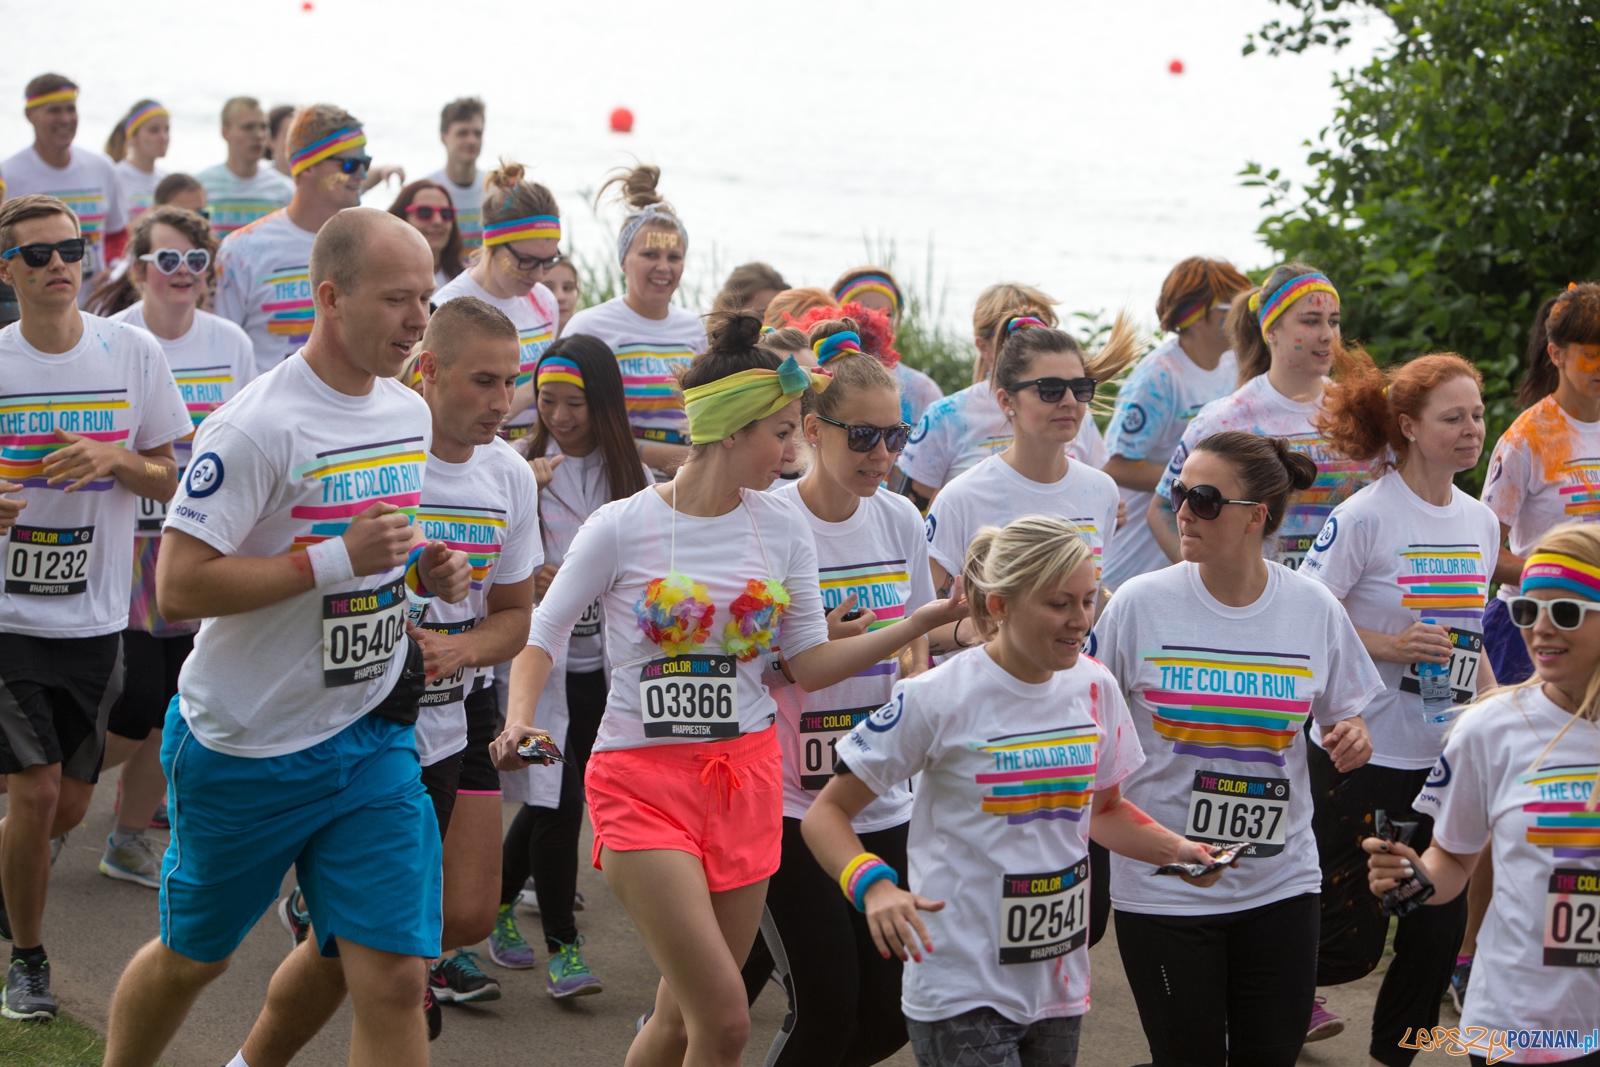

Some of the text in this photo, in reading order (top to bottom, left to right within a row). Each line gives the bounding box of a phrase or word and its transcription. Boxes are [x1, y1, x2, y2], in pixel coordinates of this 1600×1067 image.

[275, 282, 298, 300] THE
[620, 359, 644, 375] THE
[0, 412, 26, 434] THE
[29, 411, 80, 434] COLOR
[321, 463, 422, 502] THE COLOR RUN
[17, 529, 31, 542] THE
[32, 531, 58, 544] COLOR
[425, 521, 466, 541] COLOR
[468, 525, 494, 544] RUN
[12, 548, 88, 580] 01232
[1410, 558, 1477, 574] THE COLOR RUN
[29, 583, 70, 594] #HAPPIEST5K
[331, 590, 392, 614] THE COLOR RUN
[330, 614, 405, 664] 05404
[646, 660, 710, 677] THE COLOR RUN
[1160, 666, 1297, 699] THE COLOR RUN
[646, 682, 732, 718] 03366
[672, 724, 711, 735] #HAPPIEST5K
[806, 717, 822, 729] THE
[823, 715, 852, 728] COLOR
[993, 744, 1092, 771] THE COLOR RUN
[1201, 776, 1265, 796] THE COLOR RUN
[1538, 783, 1568, 801] THE
[1192, 798, 1283, 841] 01637
[1011, 872, 1074, 893] THE COLOR RUN
[1556, 874, 1600, 892] THE COL
[1007, 888, 1084, 943] 02541
[1551, 901, 1600, 944] 02
[1030, 941, 1071, 959] #HAPPIEST5K
